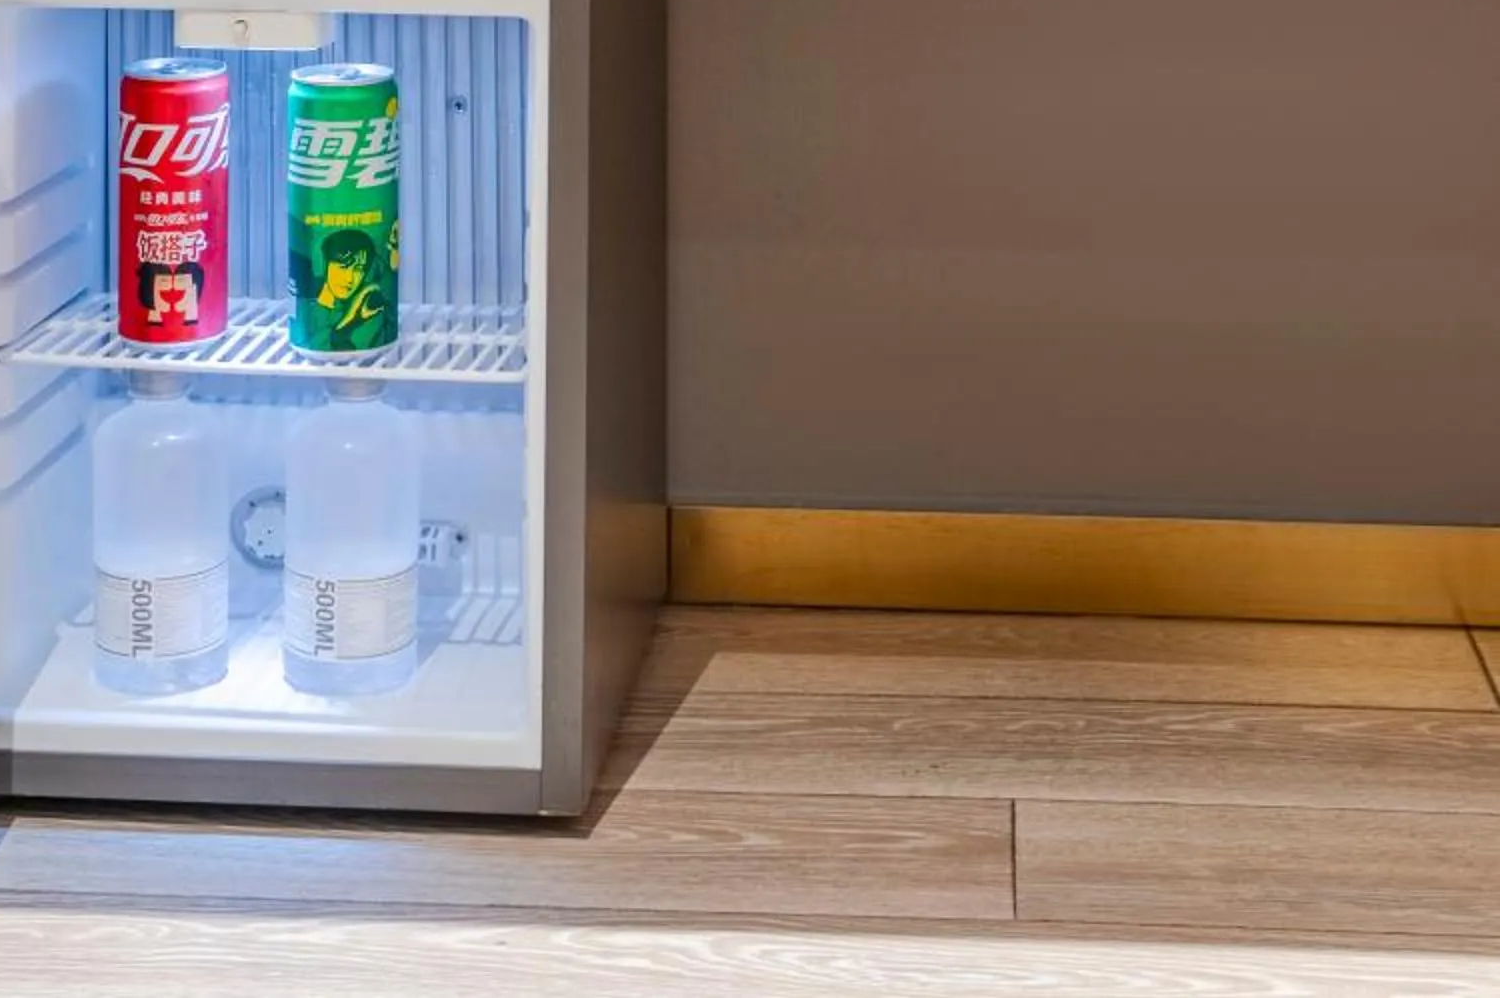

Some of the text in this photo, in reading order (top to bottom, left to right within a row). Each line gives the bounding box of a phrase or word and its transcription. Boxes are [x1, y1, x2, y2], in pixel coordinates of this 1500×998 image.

[119, 102, 230, 182] 口可
[137, 230, 208, 263] 饭搭子
[131, 579, 153, 658] 500ML
[314, 579, 336, 658] 500ML
